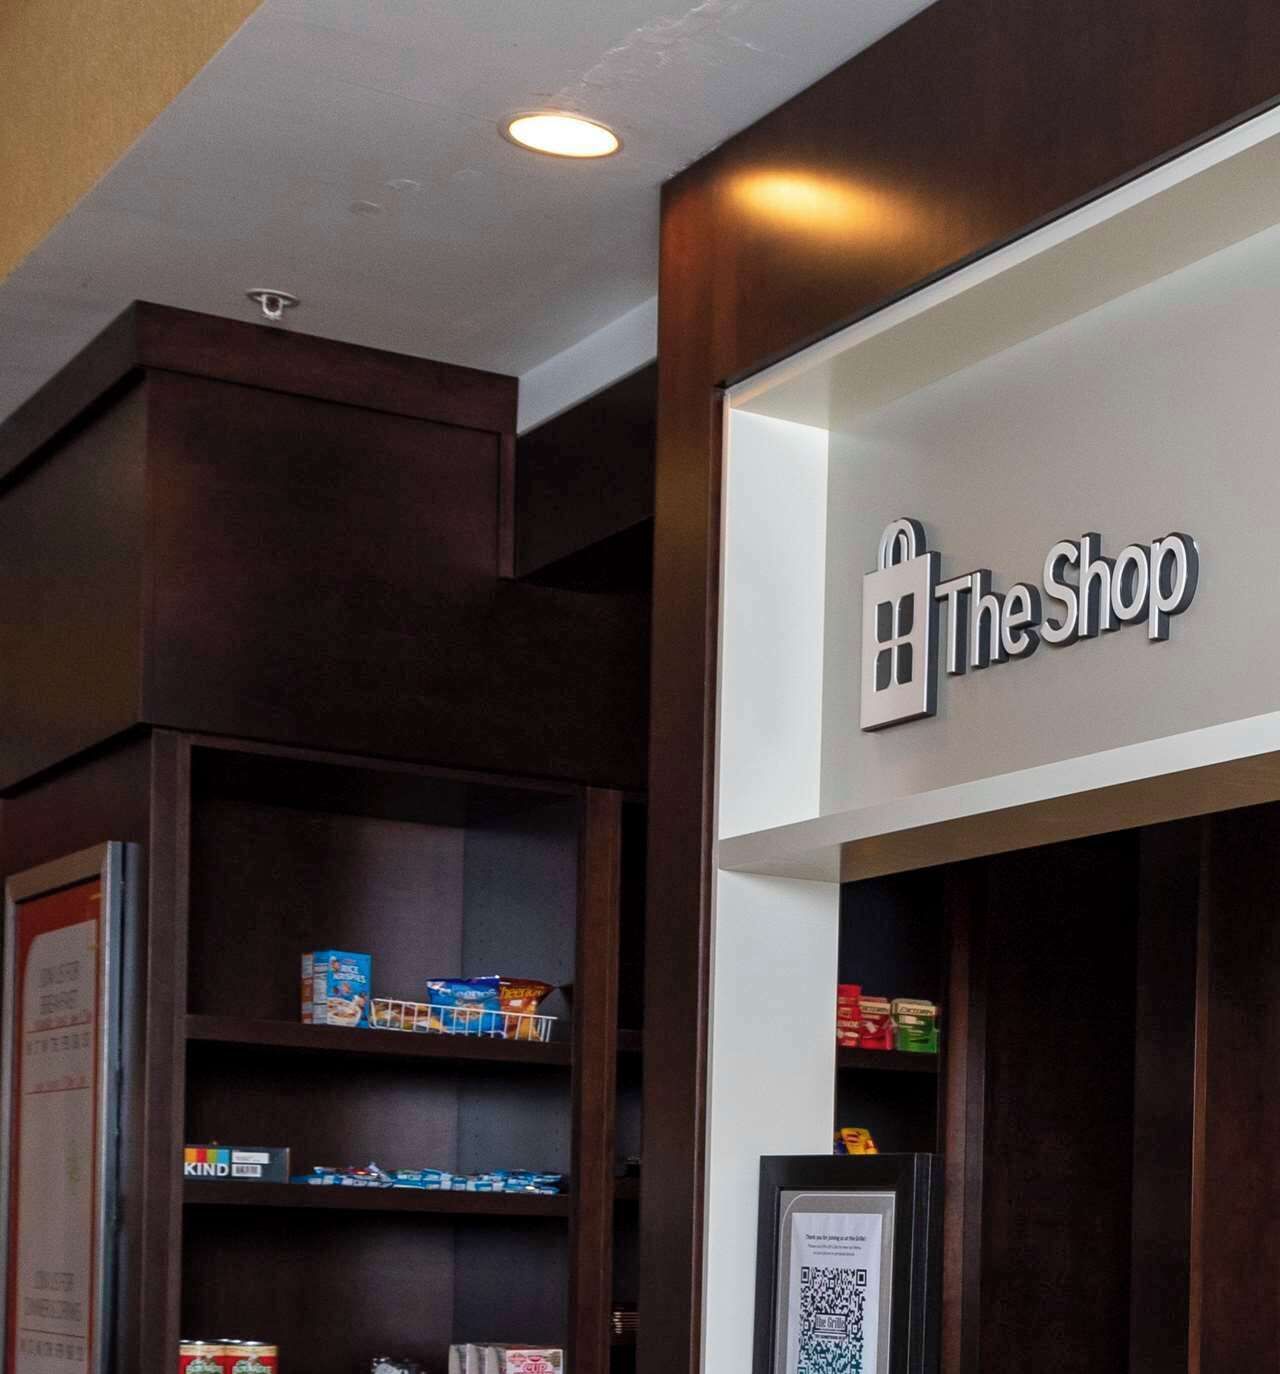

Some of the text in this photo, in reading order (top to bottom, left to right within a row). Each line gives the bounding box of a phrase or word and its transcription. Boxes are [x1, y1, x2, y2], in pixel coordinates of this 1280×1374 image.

[935, 531, 1200, 675] The Shop
[184, 1162, 230, 1177] KIND
[522, 1363, 547, 1373] CUP
